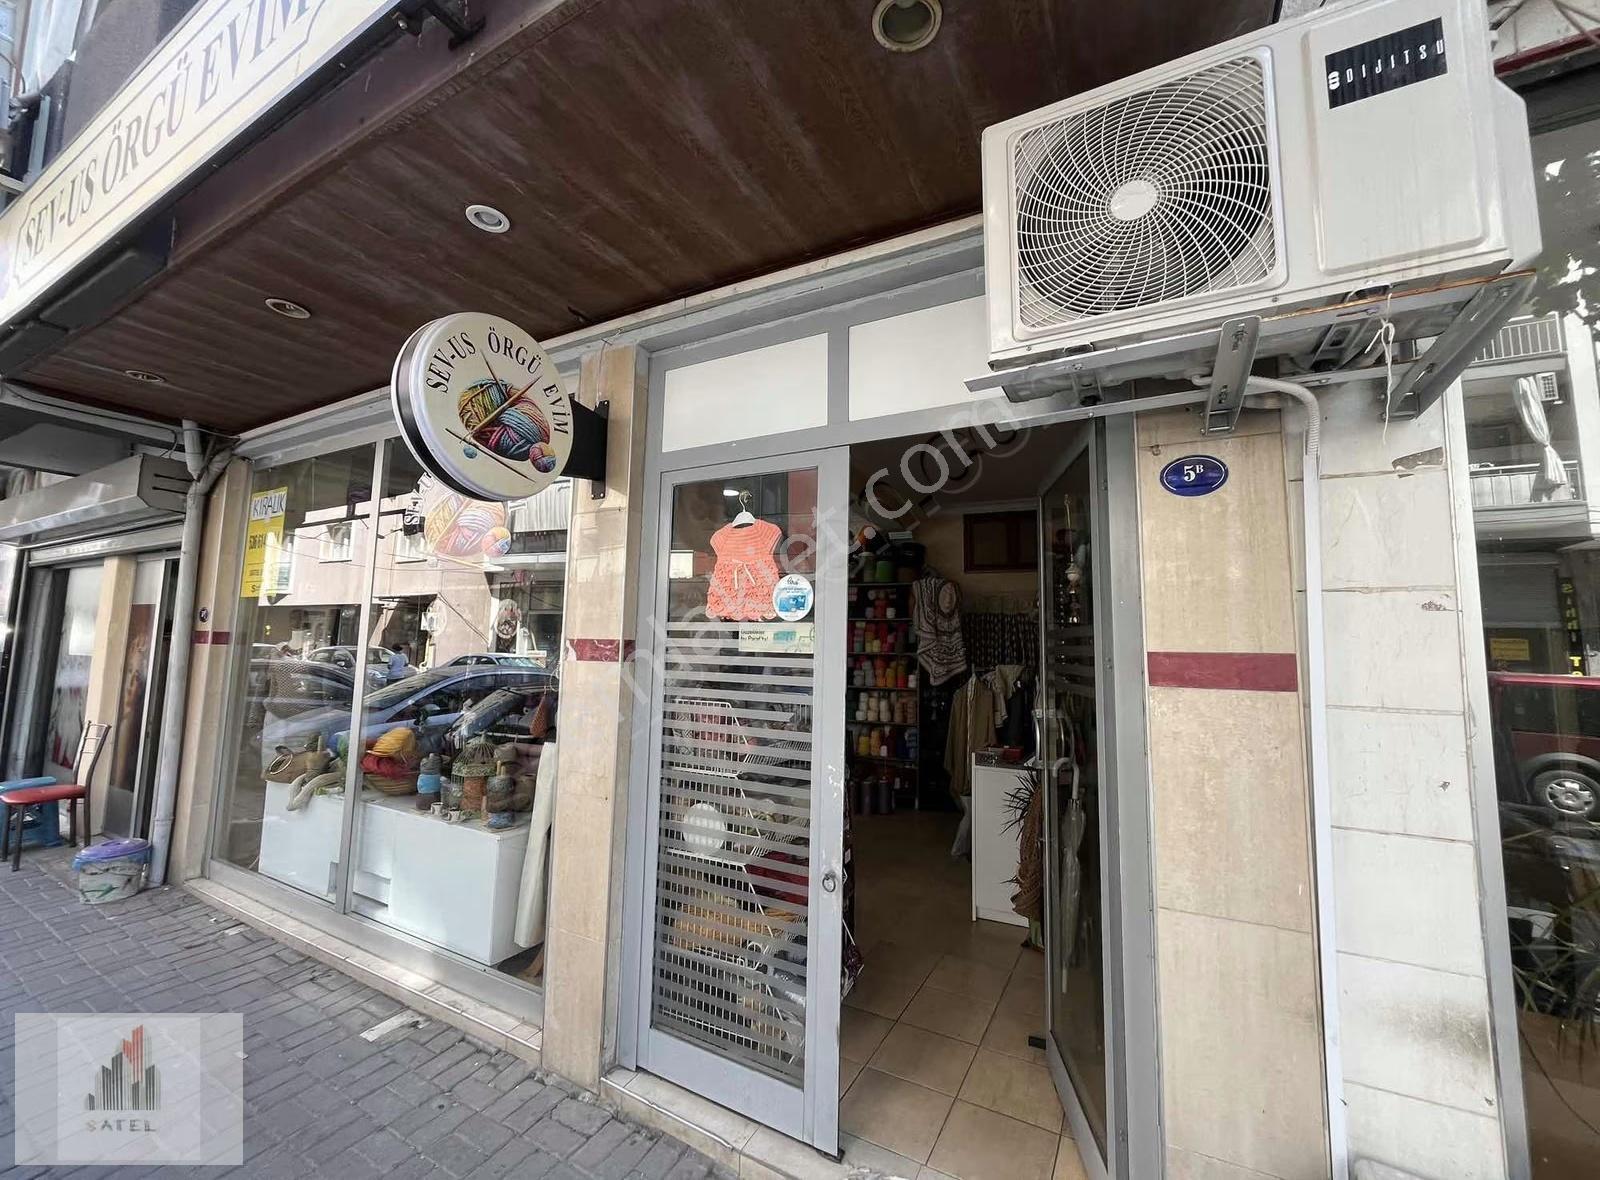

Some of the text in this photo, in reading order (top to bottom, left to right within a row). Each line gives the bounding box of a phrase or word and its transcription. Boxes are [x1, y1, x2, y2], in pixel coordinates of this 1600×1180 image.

[1345, 39, 1445, 83] DIJITSU
[21, 157, 98, 267] SEV-US
[101, 52, 193, 196] ÖRGÜ
[426, 326, 569, 435] SEV-US ÖRGÜ EVİM
[251, 493, 286, 517] KIRALIK
